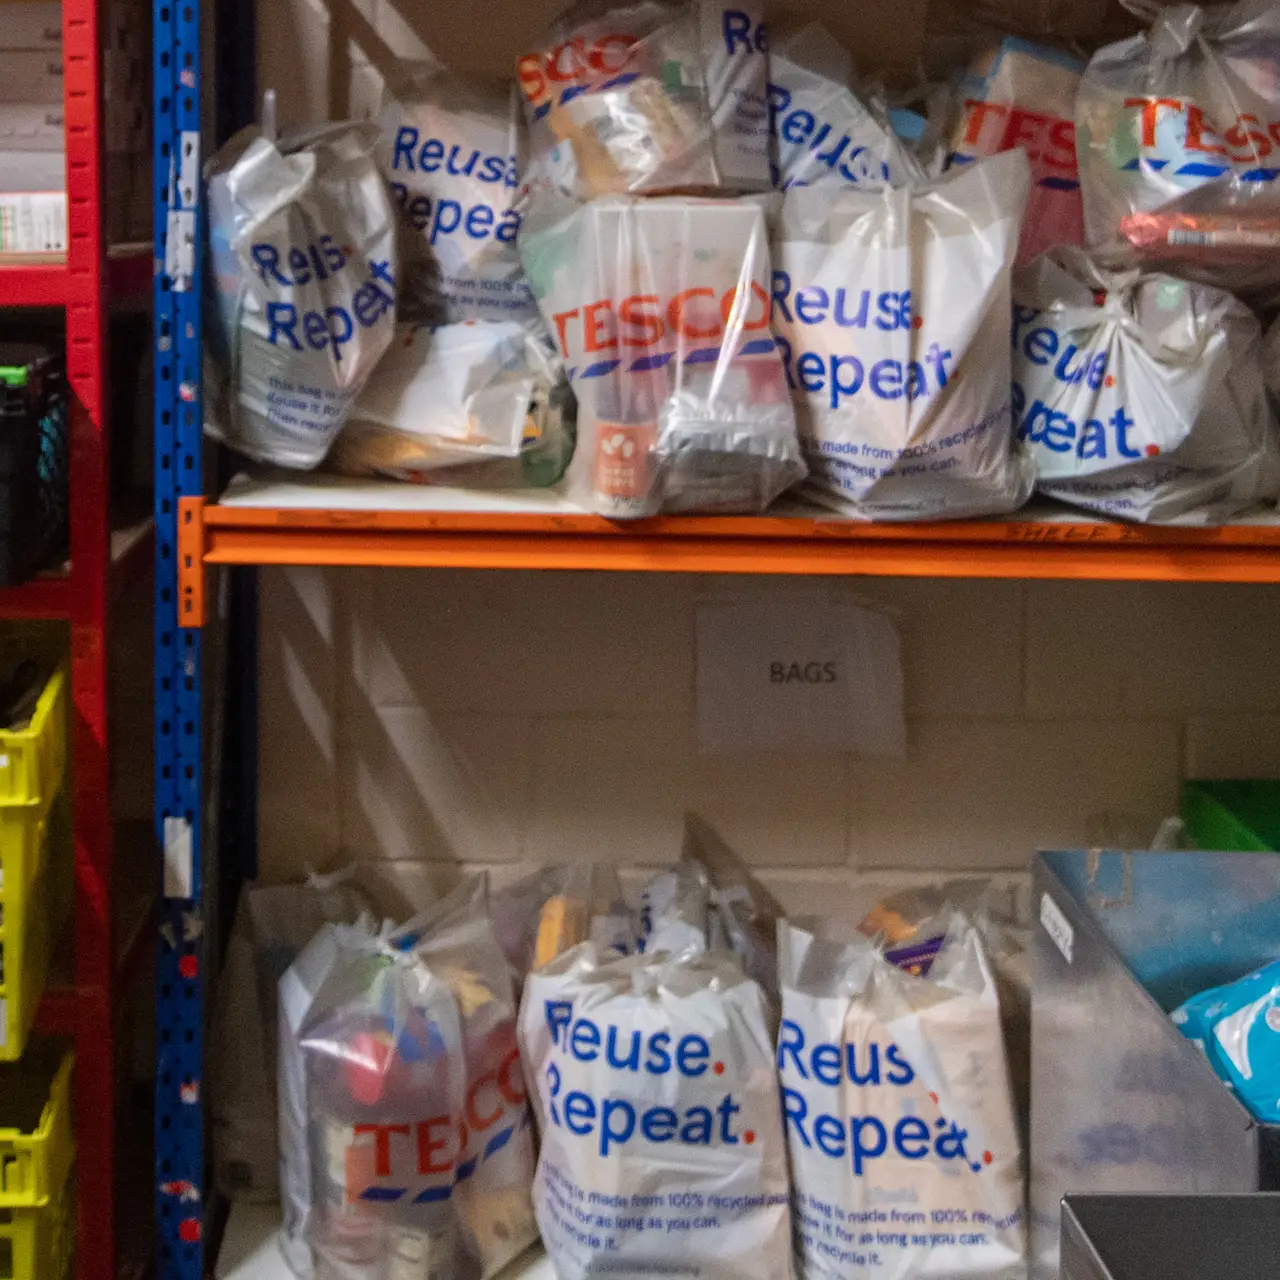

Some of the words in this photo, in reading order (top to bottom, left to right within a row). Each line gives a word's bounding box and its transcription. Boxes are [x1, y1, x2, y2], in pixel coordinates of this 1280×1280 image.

[517, 34, 642, 104] SCO
[964, 100, 1079, 176] TES
[392, 181, 521, 245] Repea
[552, 287, 772, 360] TESCO
[769, 660, 837, 685] BAGS
[545, 999, 727, 1077] Reuse.
[779, 1018, 917, 1088] Reus
[545, 1064, 757, 1158] Repeat.
[876, 1232, 908, 1249] long
[890, 1209, 926, 1224] from
[929, 1209, 968, 1224] 100%
